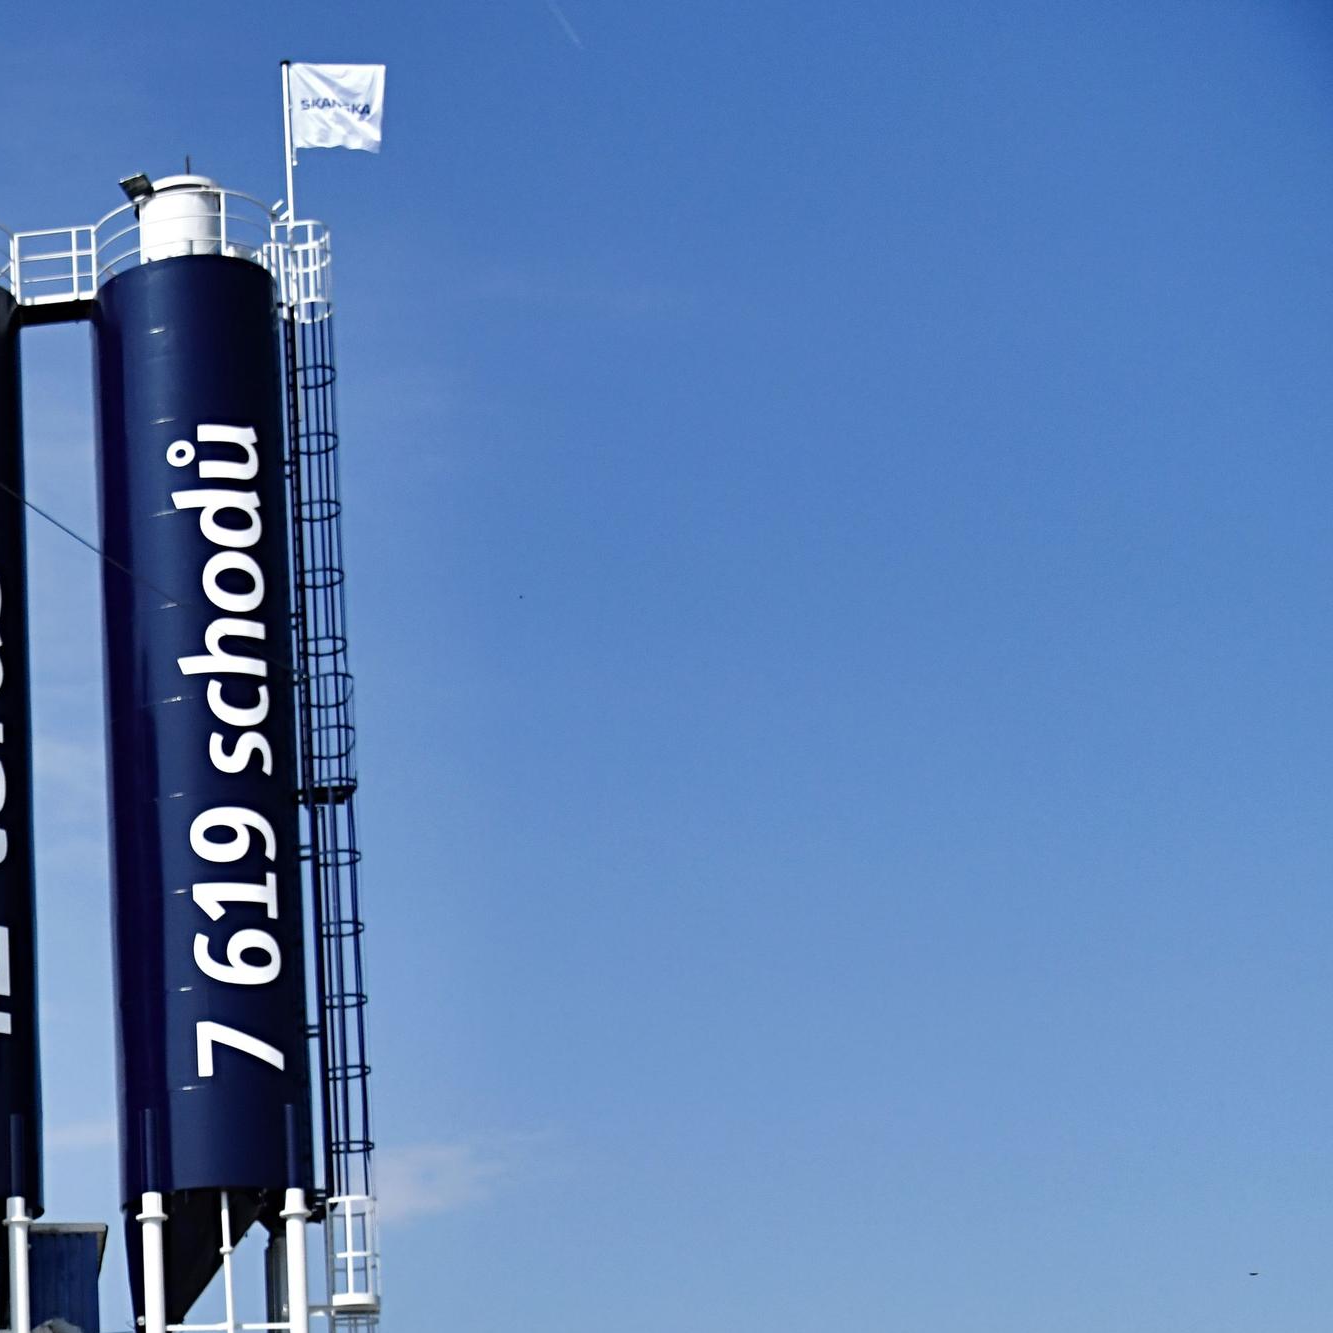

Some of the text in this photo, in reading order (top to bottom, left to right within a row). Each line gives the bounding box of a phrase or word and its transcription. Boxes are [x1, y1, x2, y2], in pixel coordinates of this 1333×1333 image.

[166, 424, 285, 1078] 7 619 schodů
